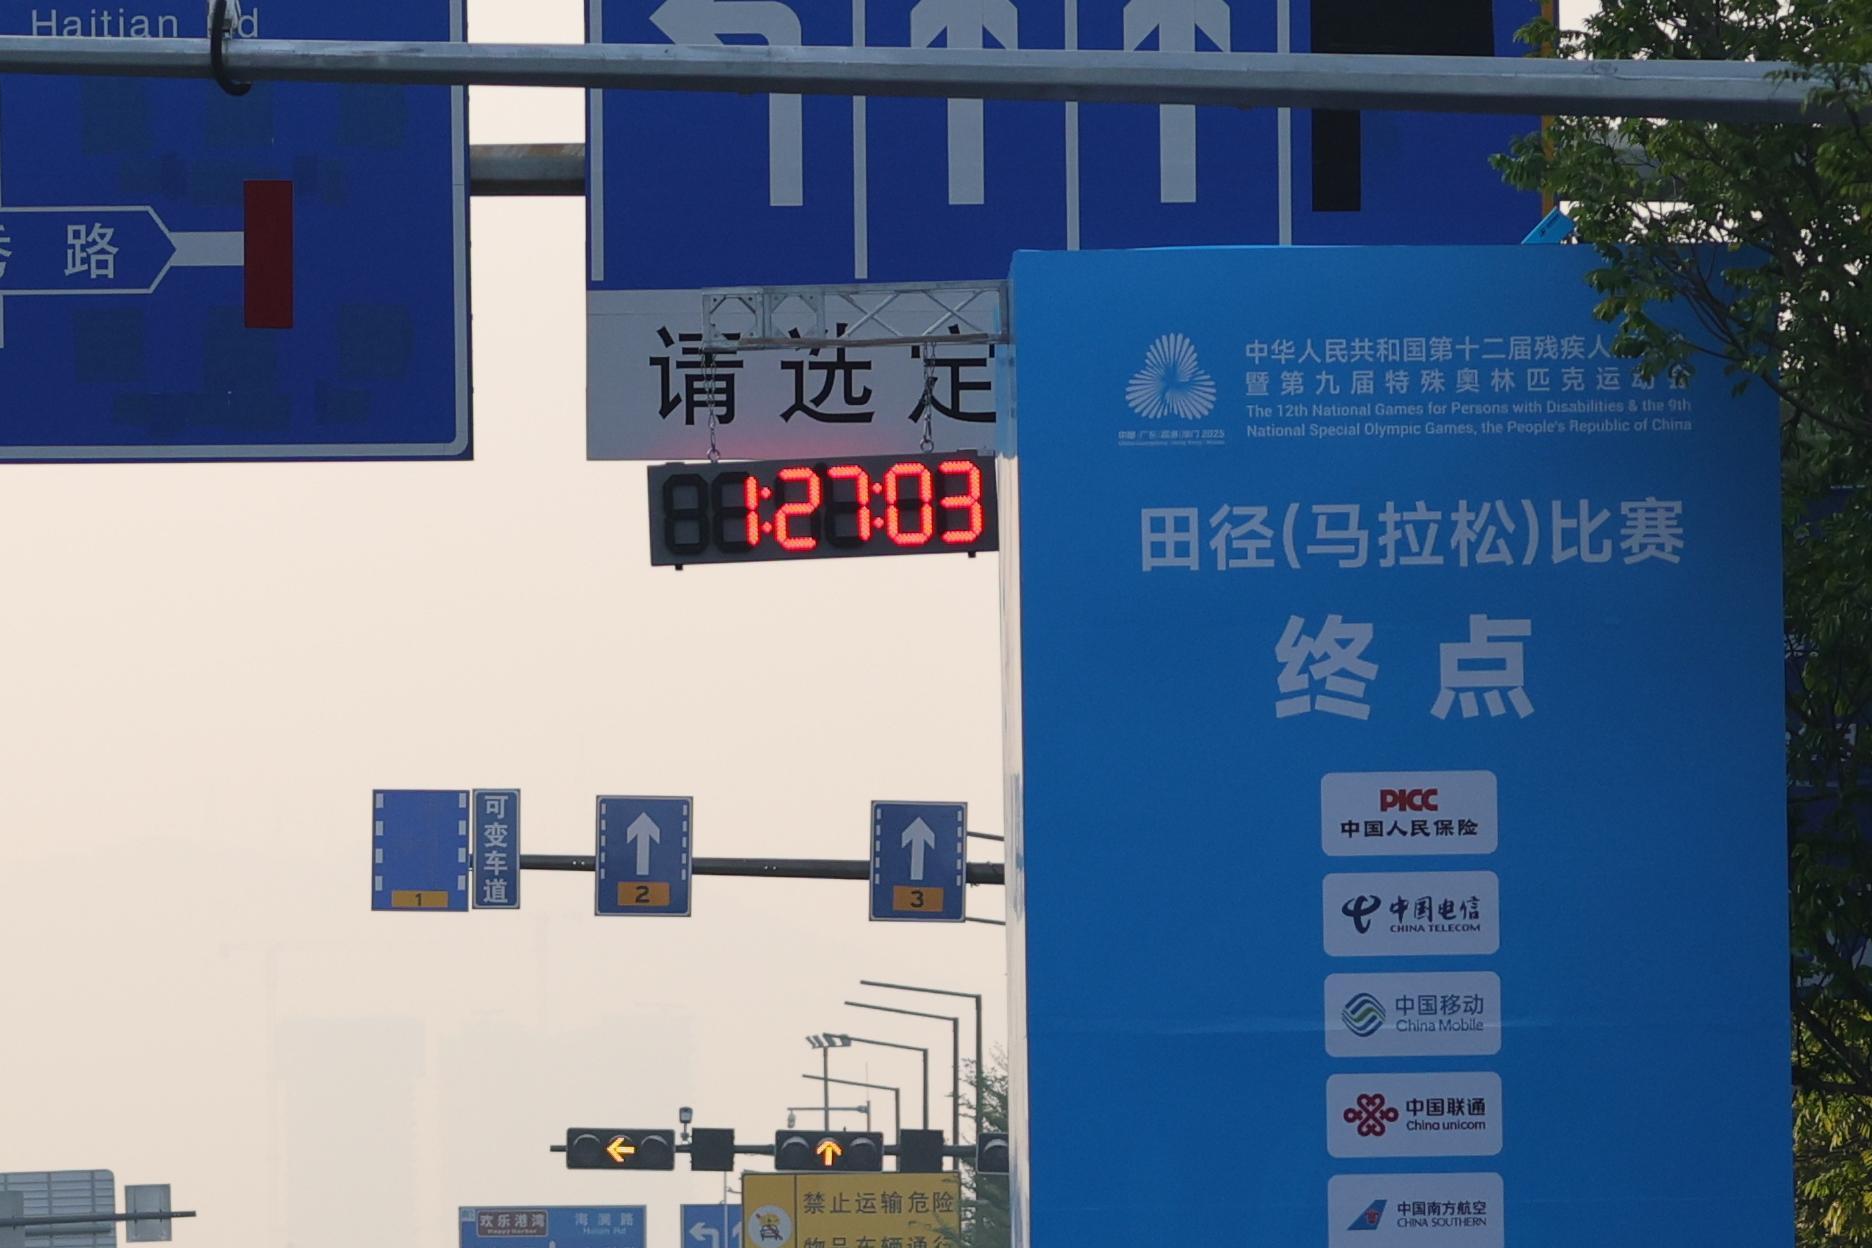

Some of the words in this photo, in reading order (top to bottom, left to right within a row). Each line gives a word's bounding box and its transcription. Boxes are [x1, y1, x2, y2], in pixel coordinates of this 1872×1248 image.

[31, 9, 178, 37] Haitian
[649, 323, 997, 425] 请选定
[1246, 404, 1273, 418] The
[1277, 404, 1308, 418] 12th
[1313, 403, 1370, 417] National
[1374, 402, 1423, 416] Games
[1427, 402, 1447, 416] for
[1451, 401, 1508, 415] Persons
[1512, 401, 1542, 414] with
[1547, 400, 1624, 414] Disabilities
[1642, 399, 1664, 412] the
[1668, 399, 1691, 412] 9th
[1246, 424, 1305, 437] National
[1310, 423, 1360, 439] Special
[1365, 422, 1421, 438] Olympic
[1425, 421, 1477, 437] Games,
[1481, 421, 1502, 434] the
[1507, 420, 1565, 436] People's
[1570, 420, 1632, 435] Republic
[1636, 419, 1651, 432] of
[1655, 418, 1692, 432] China
[744, 460, 982, 551] 1:27:03
[1142, 497, 1684, 572] 田径(马拉松)比赛
[1275, 614, 1534, 721] 终点
[1380, 789, 1438, 811] PICC
[1340, 819, 1478, 838] 中国人民保险
[483, 795, 508, 904] 可变车道
[414, 893, 423, 907] 1
[635, 886, 650, 904] 2
[909, 891, 924, 909] 3
[1390, 895, 1480, 922] 中国电信
[1390, 923, 1425, 933] CHINA
[1429, 923, 1480, 932] TELECOM
[1396, 994, 1484, 1016] 中国移动
[1396, 1019, 1436, 1033] China
[1439, 1019, 1484, 1032] Mobile
[1406, 1098, 1486, 1116] 中国联通
[1407, 1120, 1440, 1131] China
[1443, 1119, 1486, 1130] unicom
[804, 1192, 954, 1214] 禁止运输危险
[1397, 1201, 1487, 1217] 中国南方航空
[480, 1213, 545, 1228] 欢乐港湾
[1397, 1218, 1429, 1229] CHINA
[1432, 1217, 1487, 1228] SOUTHERN
